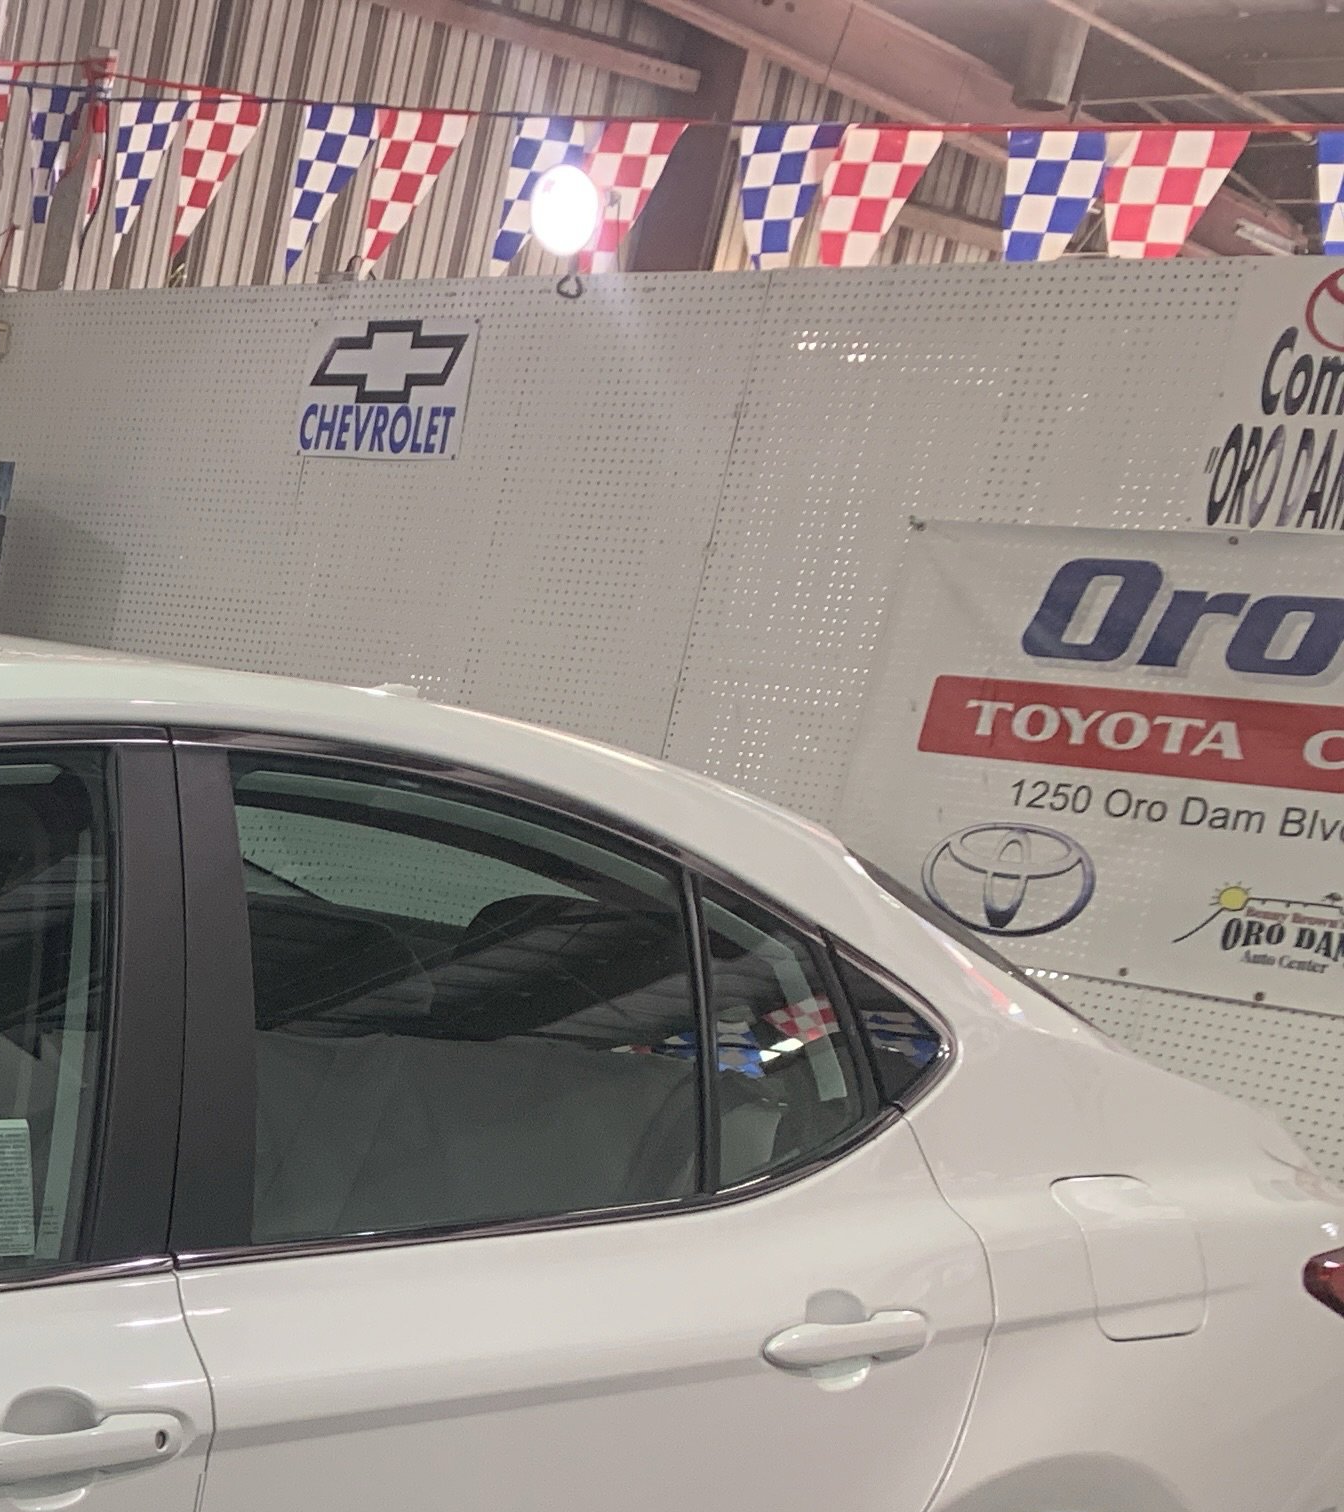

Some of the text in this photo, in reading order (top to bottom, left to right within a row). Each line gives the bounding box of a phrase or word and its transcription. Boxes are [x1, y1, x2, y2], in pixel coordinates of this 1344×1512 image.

[299, 403, 456, 455] CHEVROLET
[1204, 423, 1286, 529] "ORO
[966, 698, 1244, 760] TOYOTA
[1011, 778, 1344, 844] 1250 Oro Dam Blv
[1221, 918, 1285, 951] ORO
[1240, 950, 1276, 966] Auto
